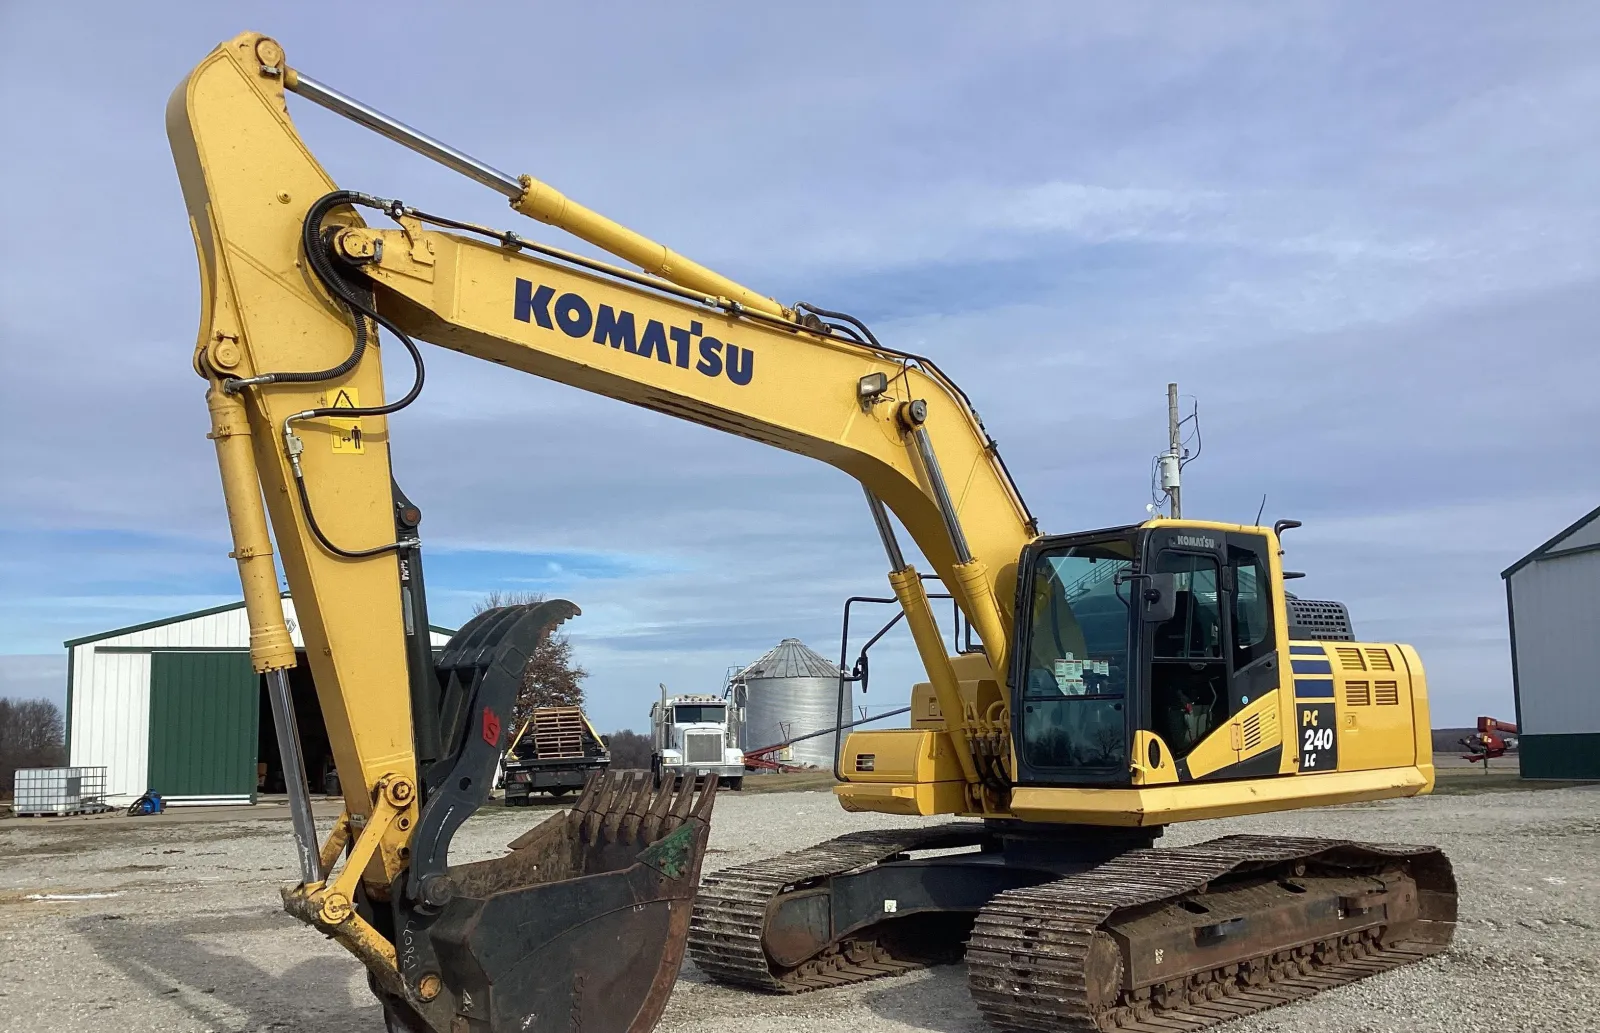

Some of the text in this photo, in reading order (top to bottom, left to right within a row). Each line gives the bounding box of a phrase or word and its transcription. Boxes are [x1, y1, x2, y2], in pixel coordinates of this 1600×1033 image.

[514, 277, 754, 386] KOMATSU
[1177, 535, 1215, 549] KOMATSU
[1303, 710, 1318, 726] PC
[1303, 728, 1333, 751] 240
[1304, 753, 1316, 767] LC
